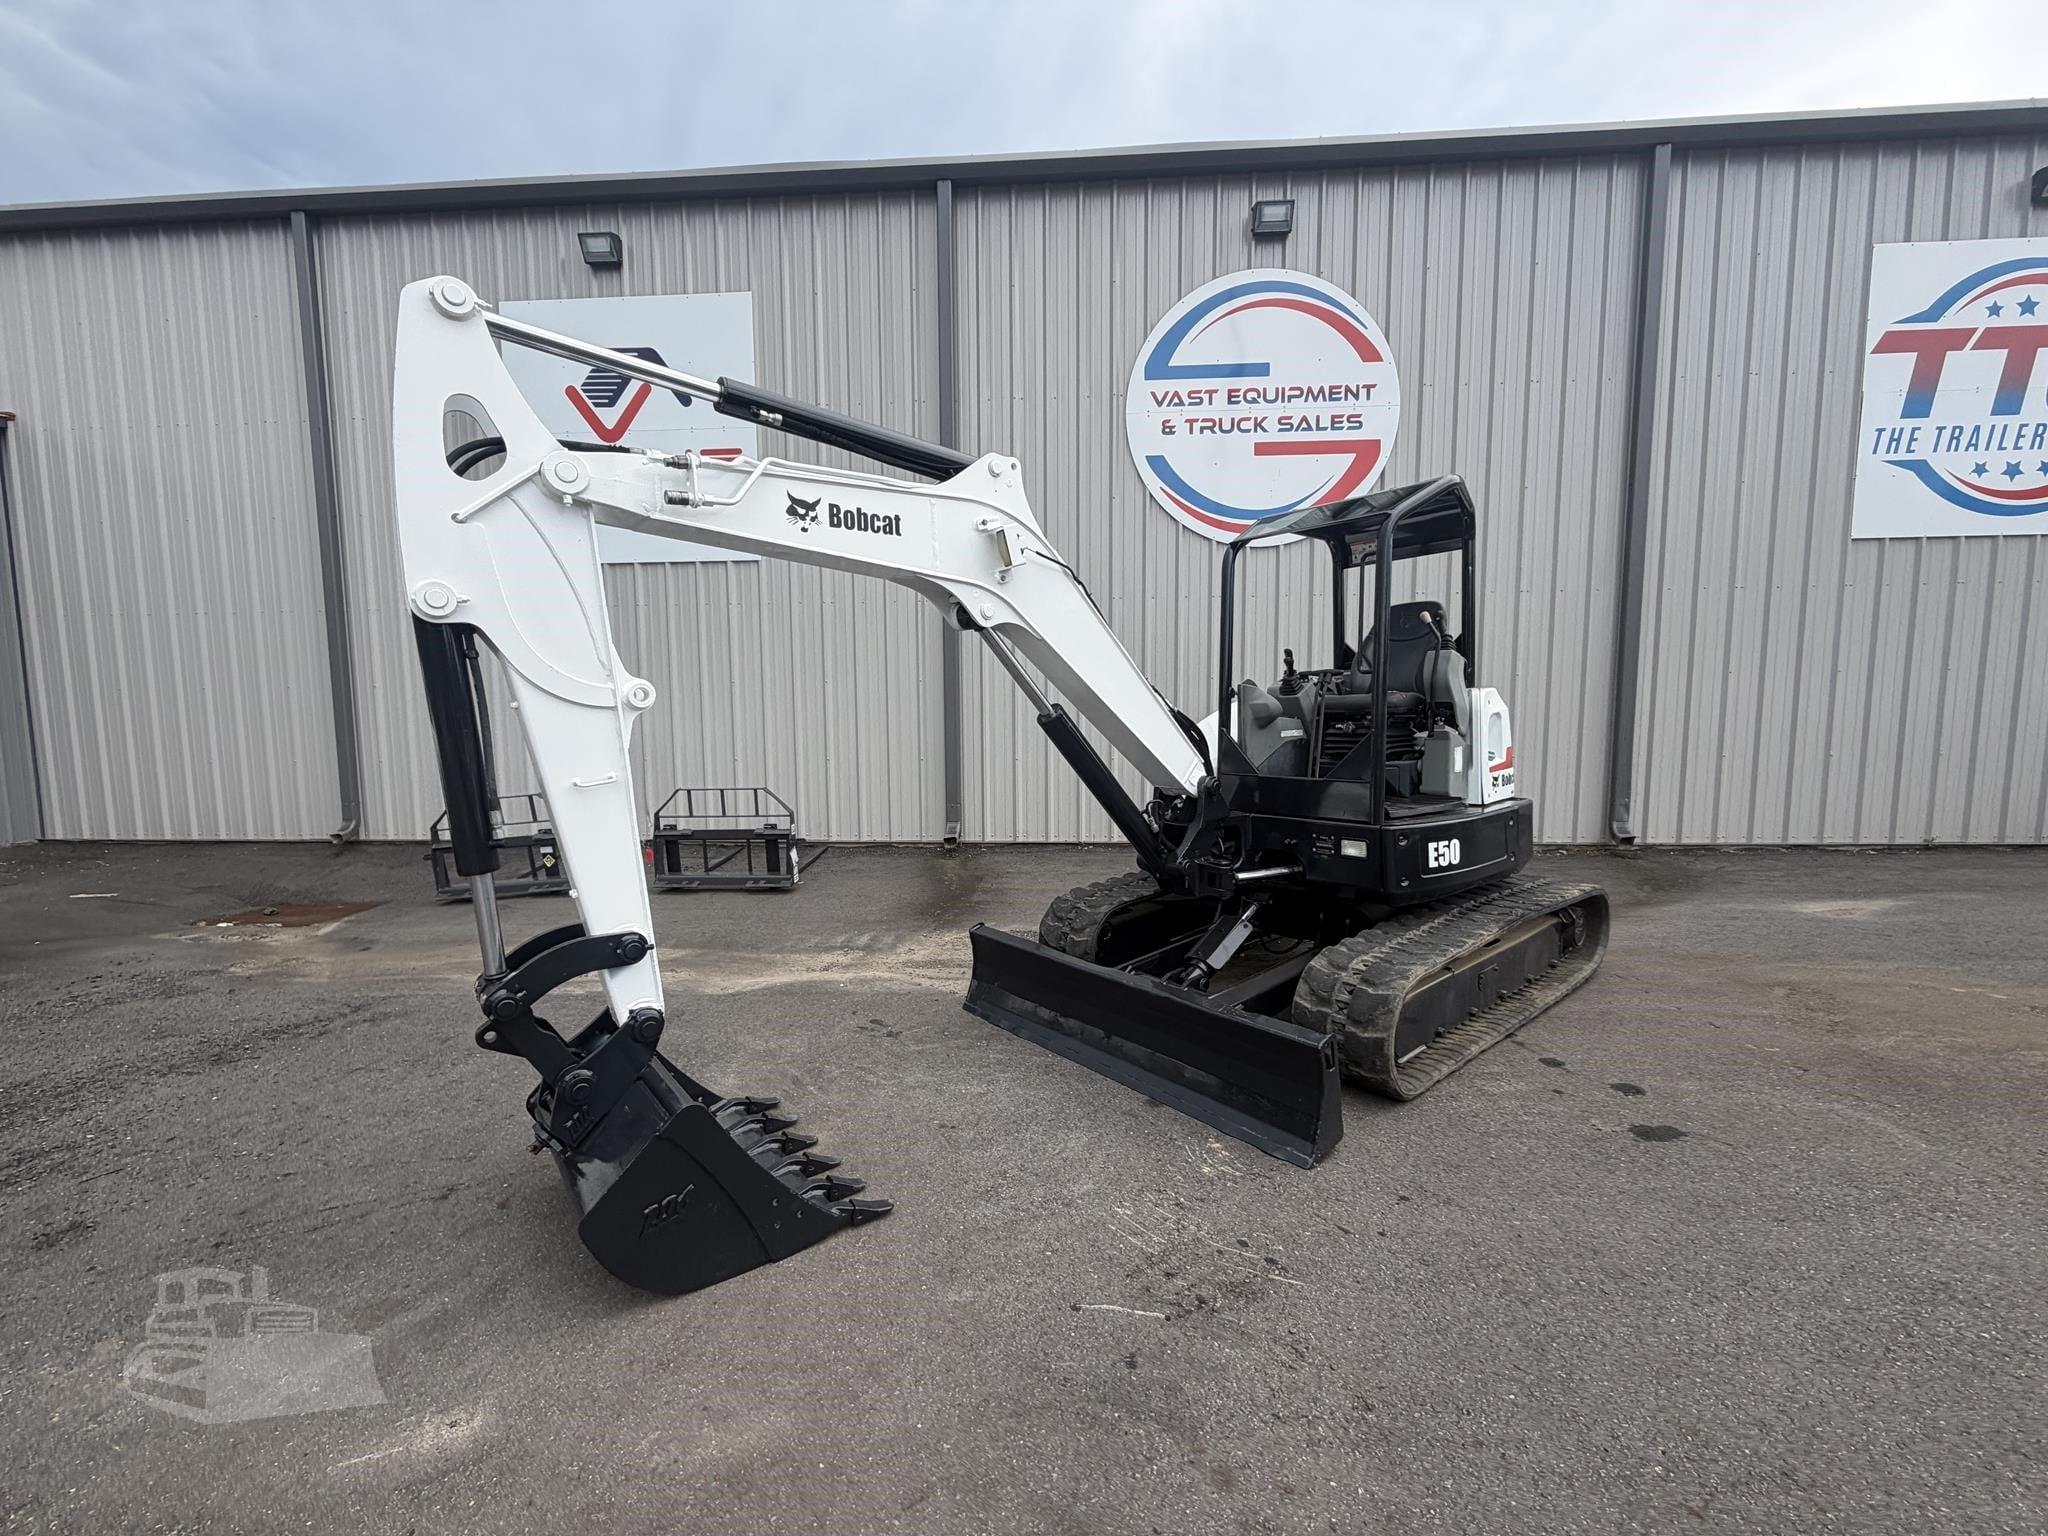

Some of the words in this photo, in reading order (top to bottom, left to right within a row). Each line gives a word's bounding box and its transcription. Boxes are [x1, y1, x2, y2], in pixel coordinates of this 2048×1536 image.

[1150, 388, 1219, 408] VAST
[1227, 383, 1378, 405] EQUIPMENT
[1161, 418, 1176, 436] &
[1184, 416, 1268, 435] TRUCK
[1277, 413, 1363, 433] SALES
[1872, 426, 1922, 455] THE
[1932, 422, 2048, 453] TRAILER
[828, 502, 902, 537] Bobcat
[1428, 838, 1460, 868] E50
